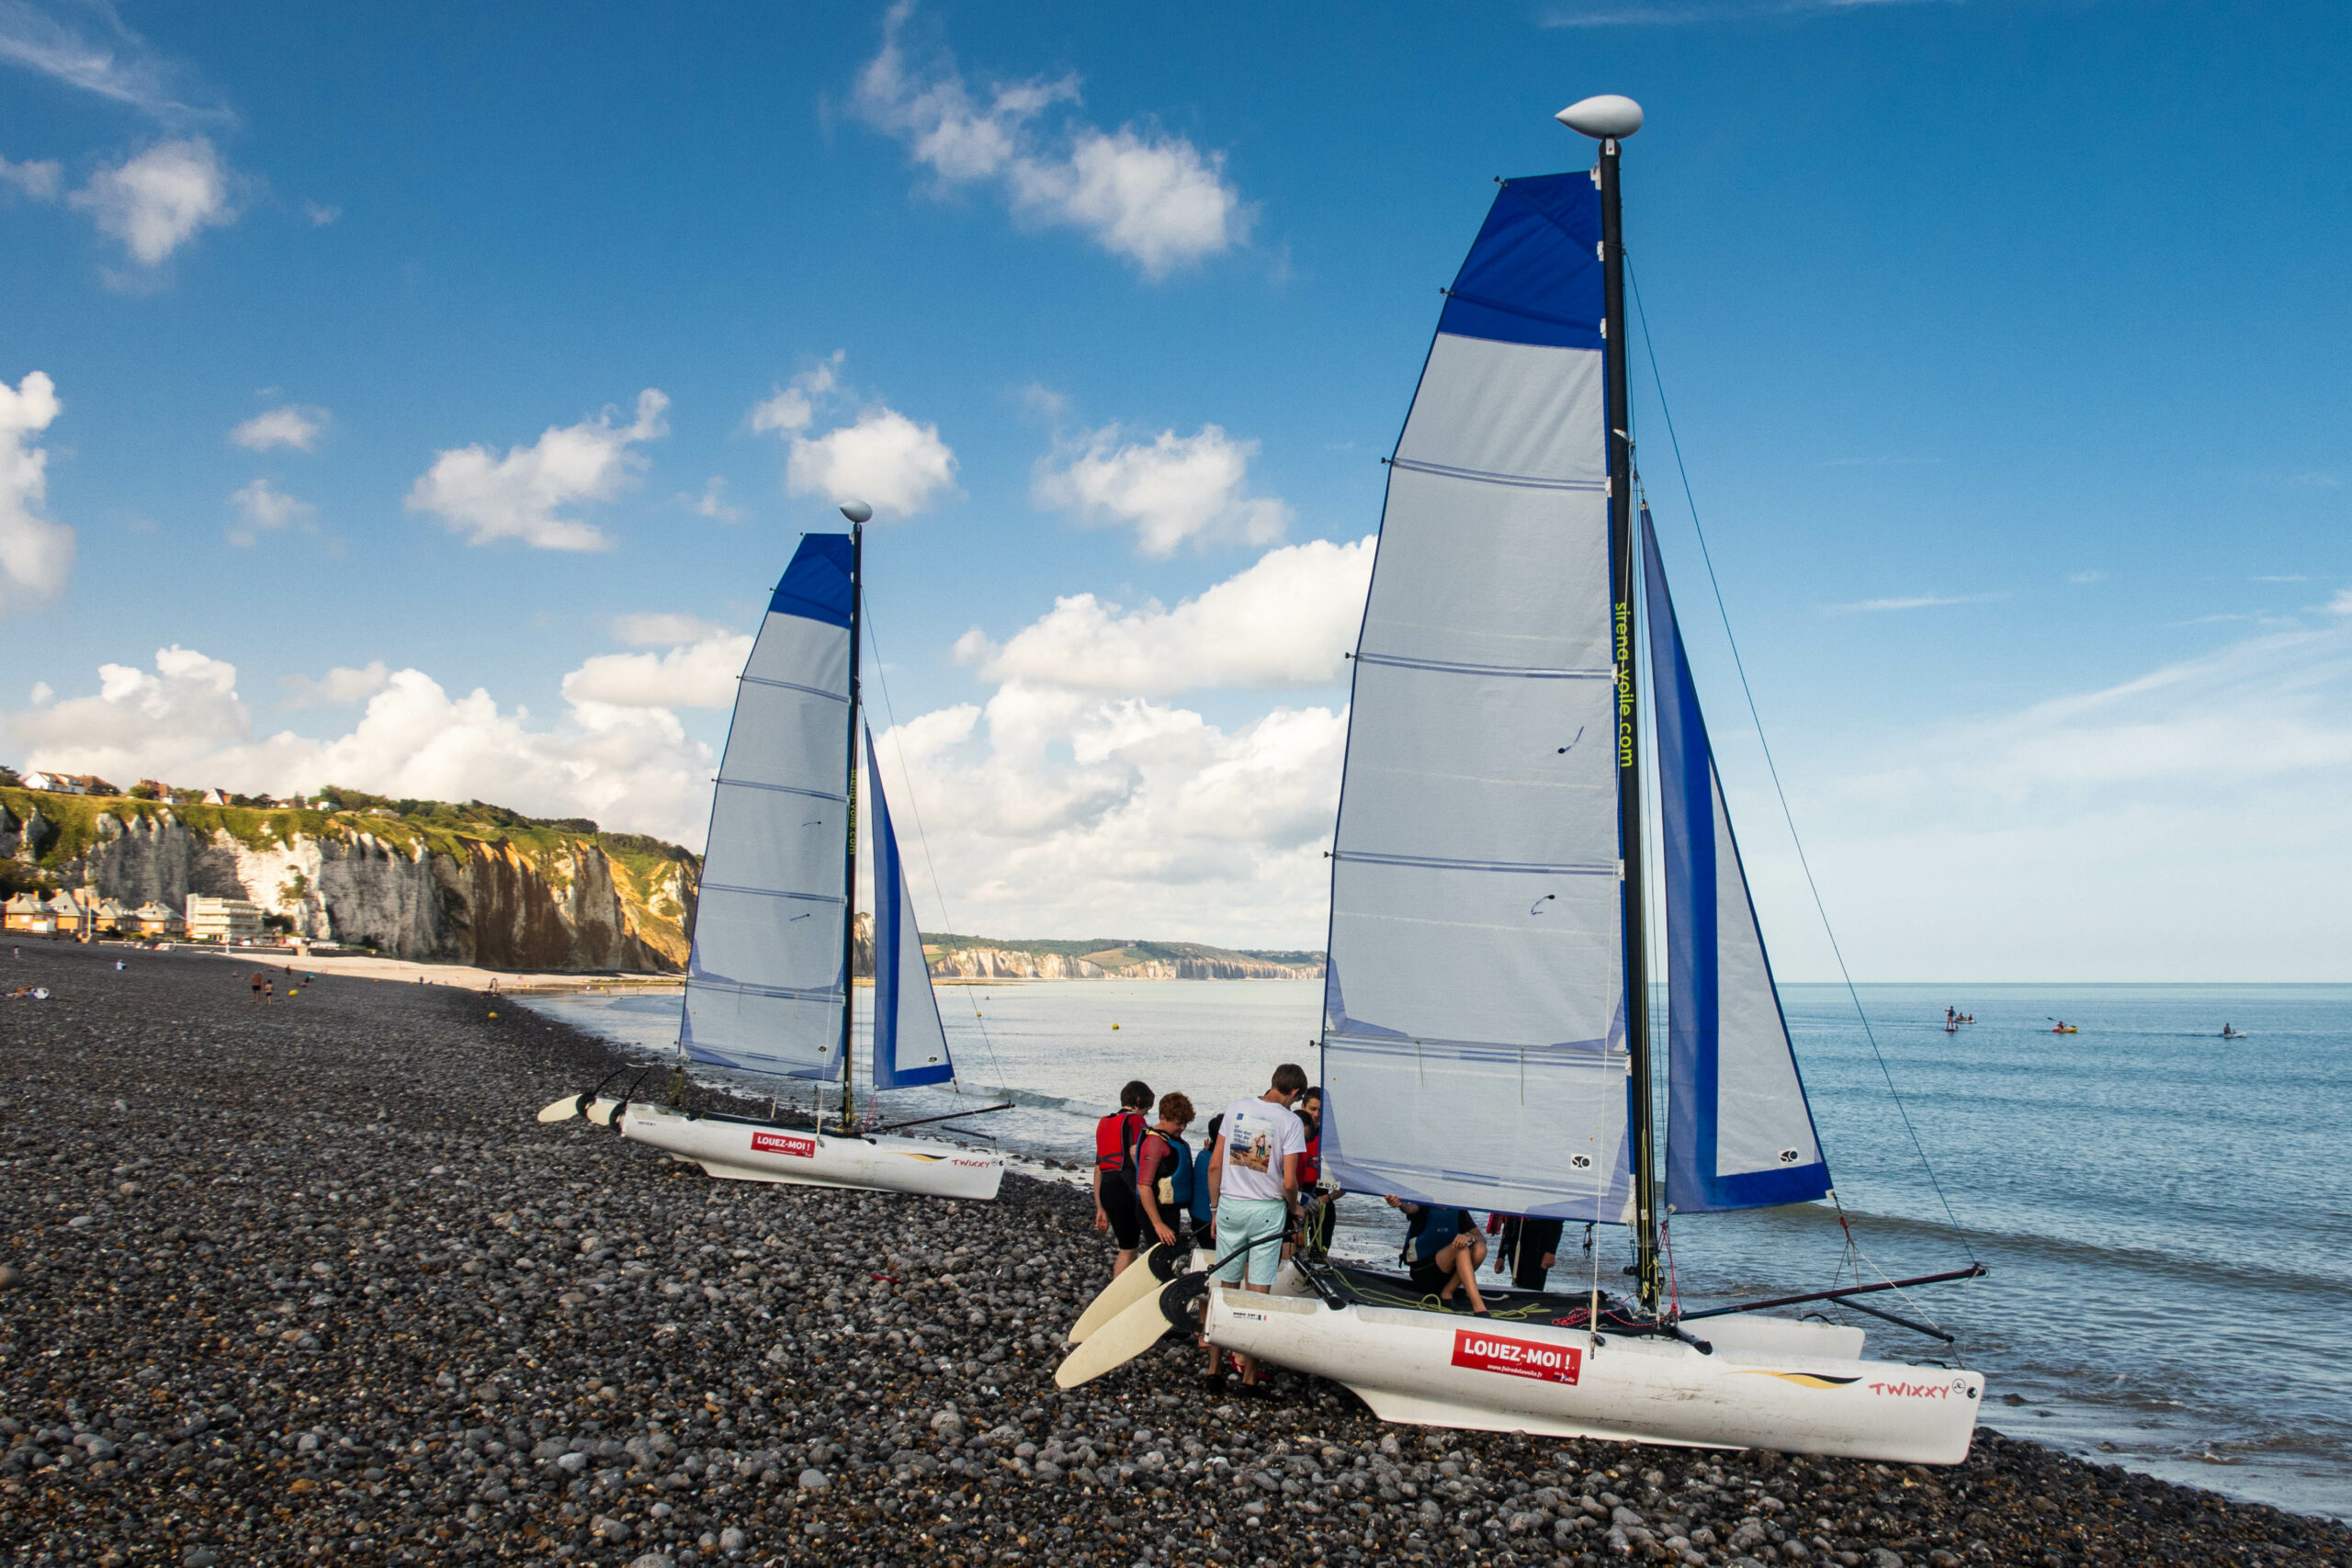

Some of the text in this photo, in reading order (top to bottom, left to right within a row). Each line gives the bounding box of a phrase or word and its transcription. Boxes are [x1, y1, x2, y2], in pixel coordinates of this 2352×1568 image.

[1615, 602, 1634, 768] sirena-voile.com
[757, 1135, 806, 1150] LOUEZ-MOI
[951, 1159, 990, 1168] TWIXXY
[1464, 1338, 1561, 1368] LOUEZ-MOI
[1869, 1381, 1950, 1400] TWIXXY
